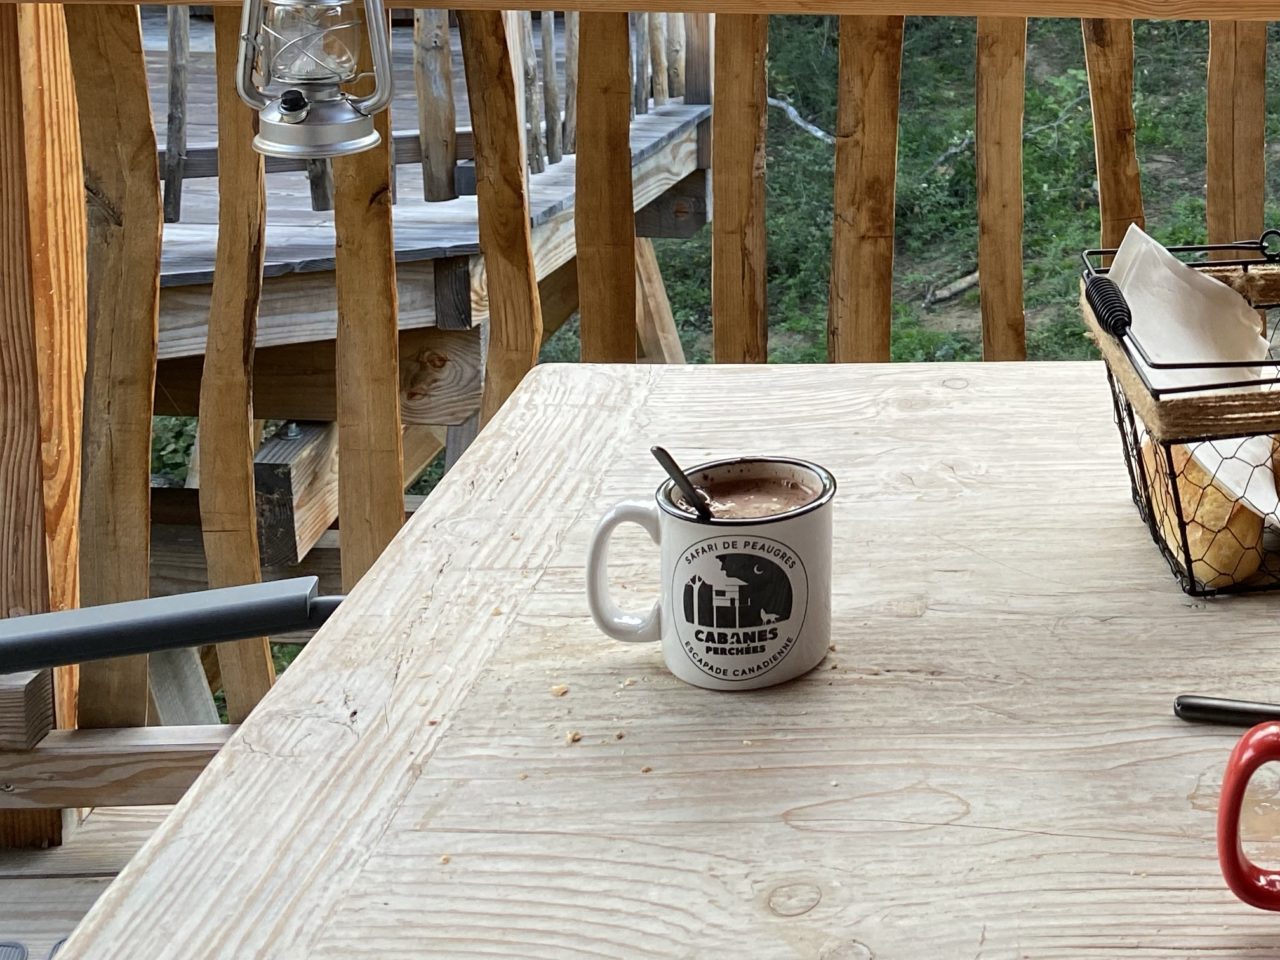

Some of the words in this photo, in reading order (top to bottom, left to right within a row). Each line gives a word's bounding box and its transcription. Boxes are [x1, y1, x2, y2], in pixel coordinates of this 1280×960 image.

[685, 543, 719, 565] SAFARI
[723, 540, 738, 550] DE
[743, 540, 797, 569] PEAUGRES
[694, 627, 779, 644] CABANES
[685, 640, 728, 677] ESCAPADE
[732, 636, 794, 677] CANADIENNE
[705, 643, 766, 656] PERCHÉES
